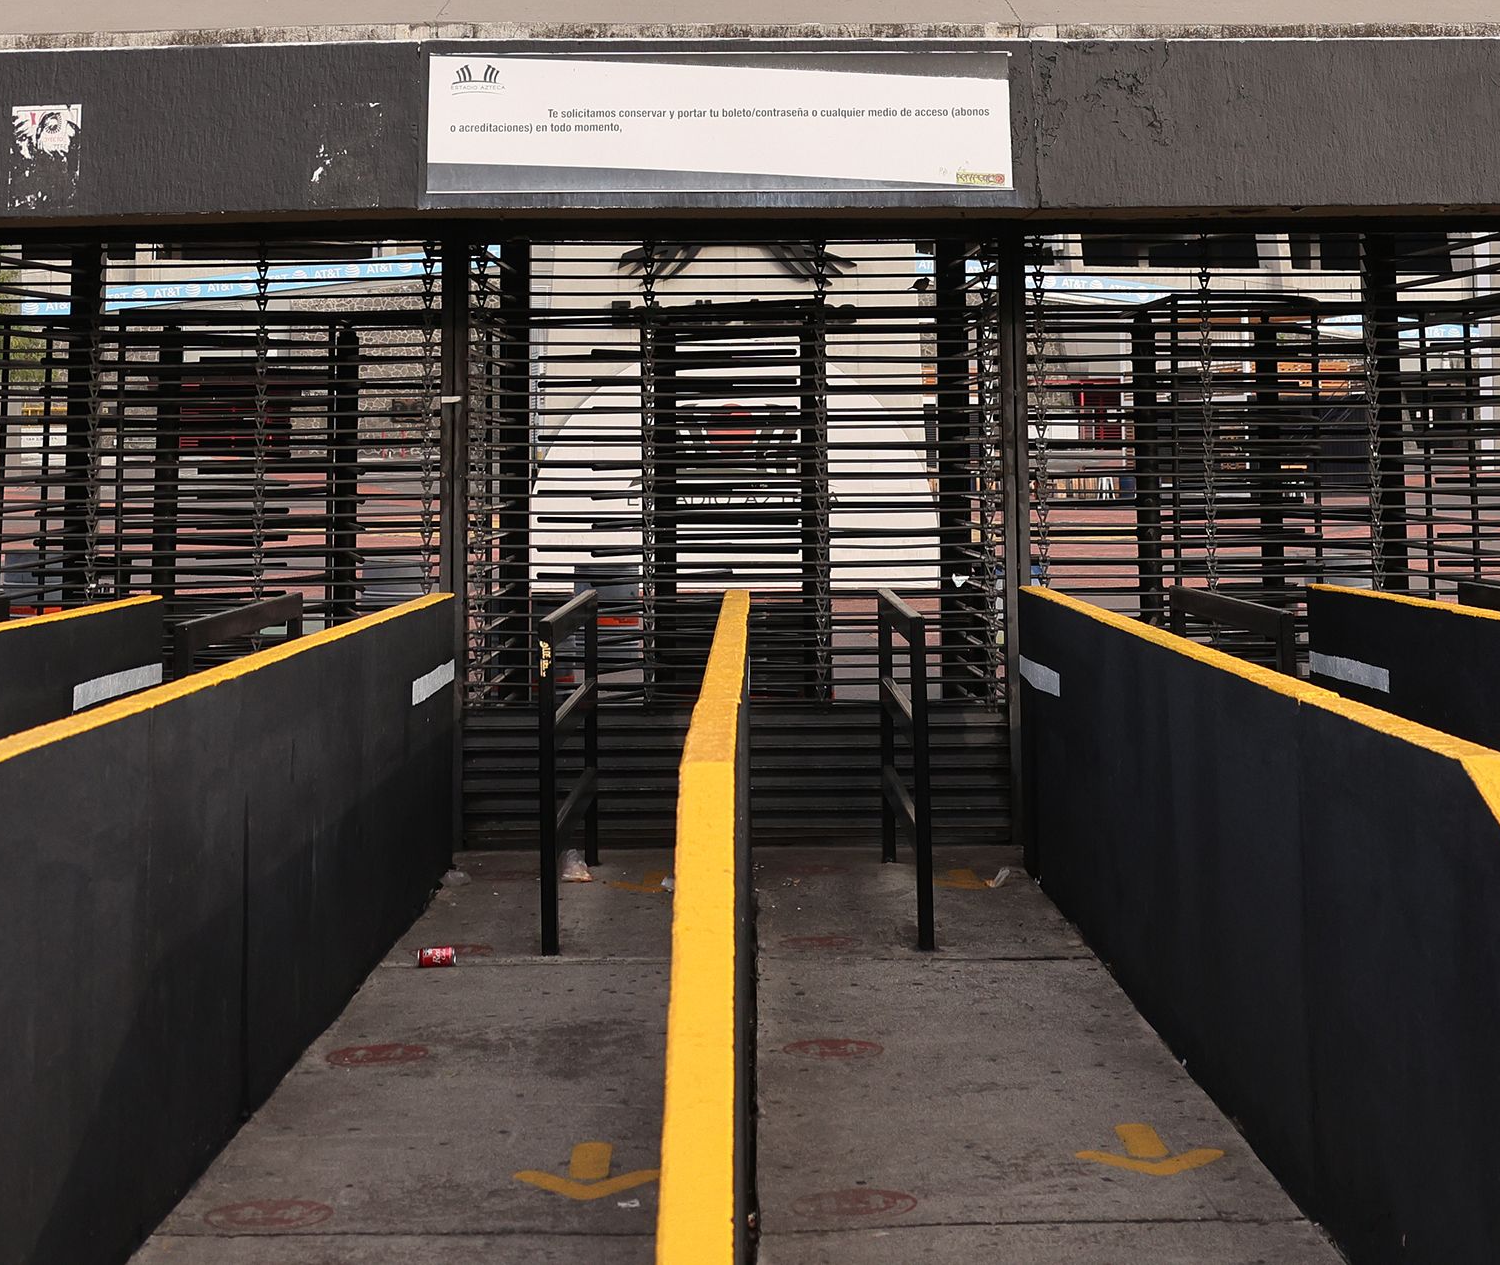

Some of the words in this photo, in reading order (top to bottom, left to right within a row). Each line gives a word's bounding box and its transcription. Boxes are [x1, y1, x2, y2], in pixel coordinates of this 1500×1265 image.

[548, 108, 559, 118] Te
[561, 107, 616, 118] solicitamos
[619, 109, 667, 118] conservar
[669, 110, 675, 120] y
[678, 109, 707, 120] portar
[709, 109, 719, 118] tu
[721, 108, 810, 117] boleto/contraseña
[819, 108, 866, 119] cualquier
[867, 108, 898, 117] medio
[899, 107, 913, 117] de
[950, 107, 990, 118] (abonos
[450, 125, 457, 133] o
[458, 123, 534, 134] acreditaciones)
[550, 123, 573, 133] todo
[574, 123, 622, 134] momento,
